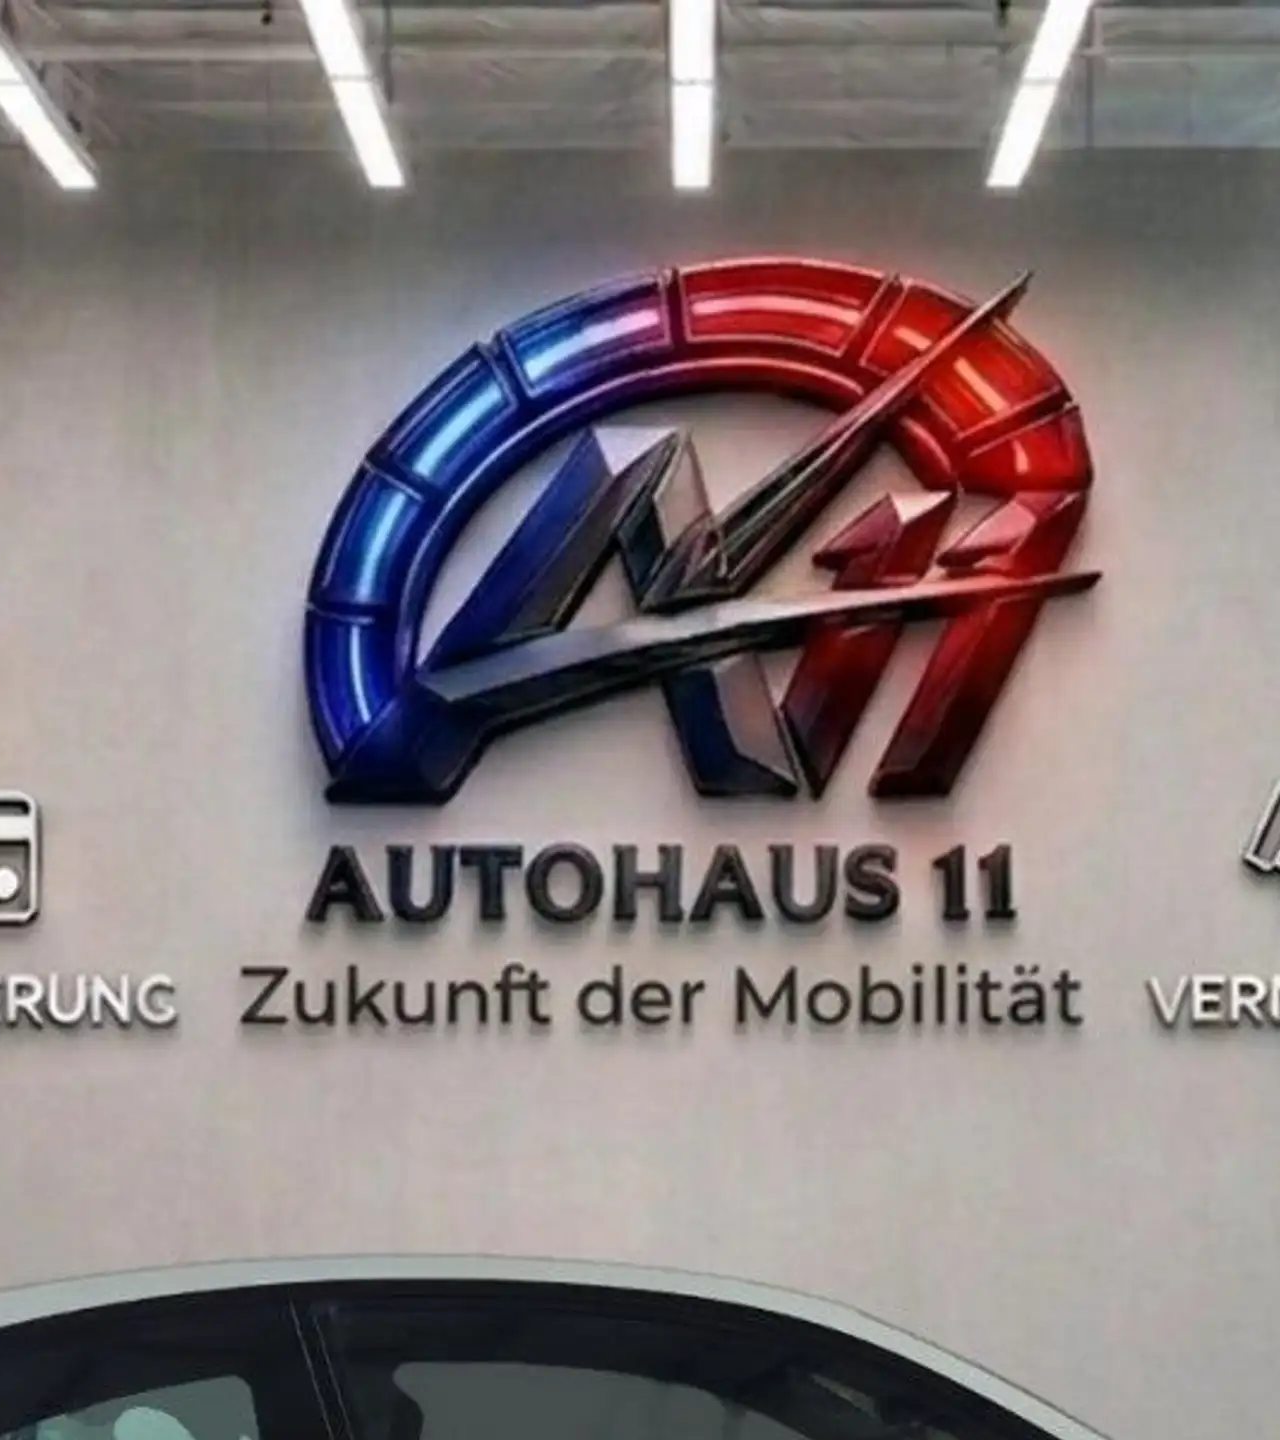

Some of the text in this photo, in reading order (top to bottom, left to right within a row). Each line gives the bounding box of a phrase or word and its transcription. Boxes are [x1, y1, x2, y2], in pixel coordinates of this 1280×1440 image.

[306, 842, 1016, 924] AUTOHAUS 11
[240, 964, 1083, 1026] Zukunft der Mobilität
